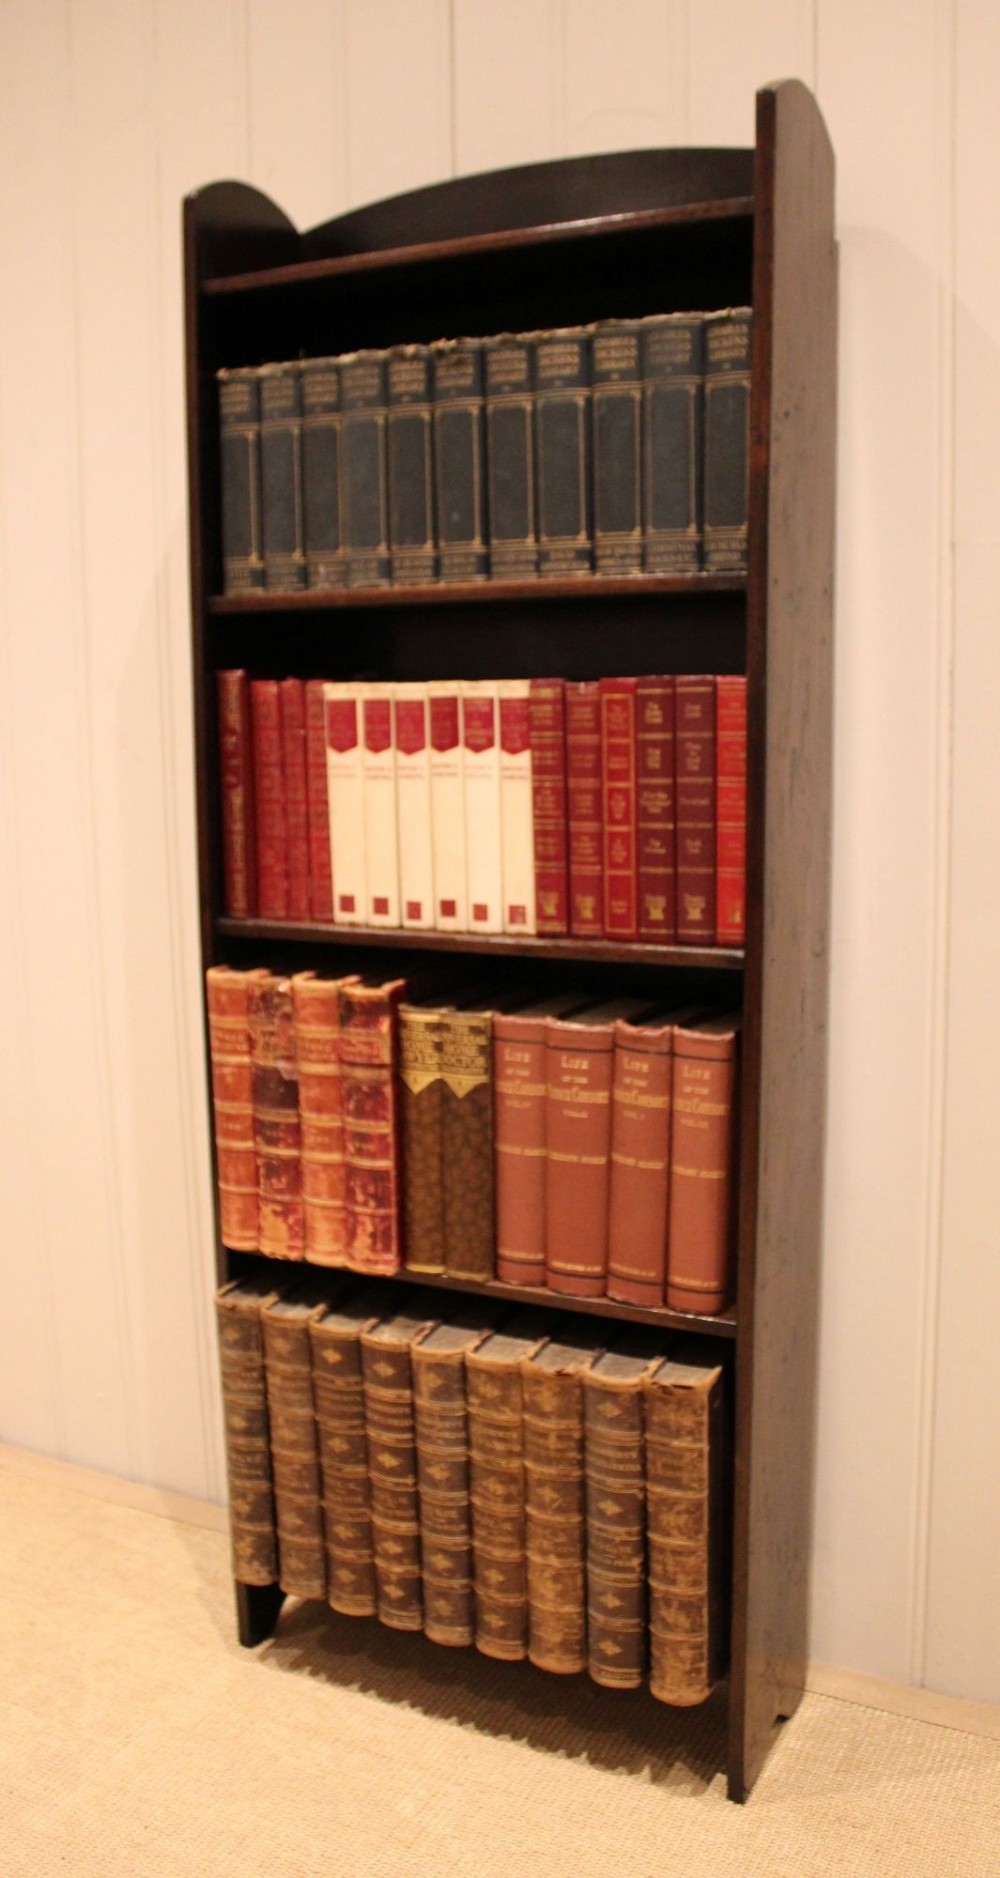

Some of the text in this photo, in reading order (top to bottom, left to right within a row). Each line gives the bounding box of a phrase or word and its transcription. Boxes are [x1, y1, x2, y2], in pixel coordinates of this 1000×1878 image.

[561, 1055, 589, 1070] LIFE
[624, 1056, 649, 1072] LIFE
[683, 1065, 711, 1080] LIFE
